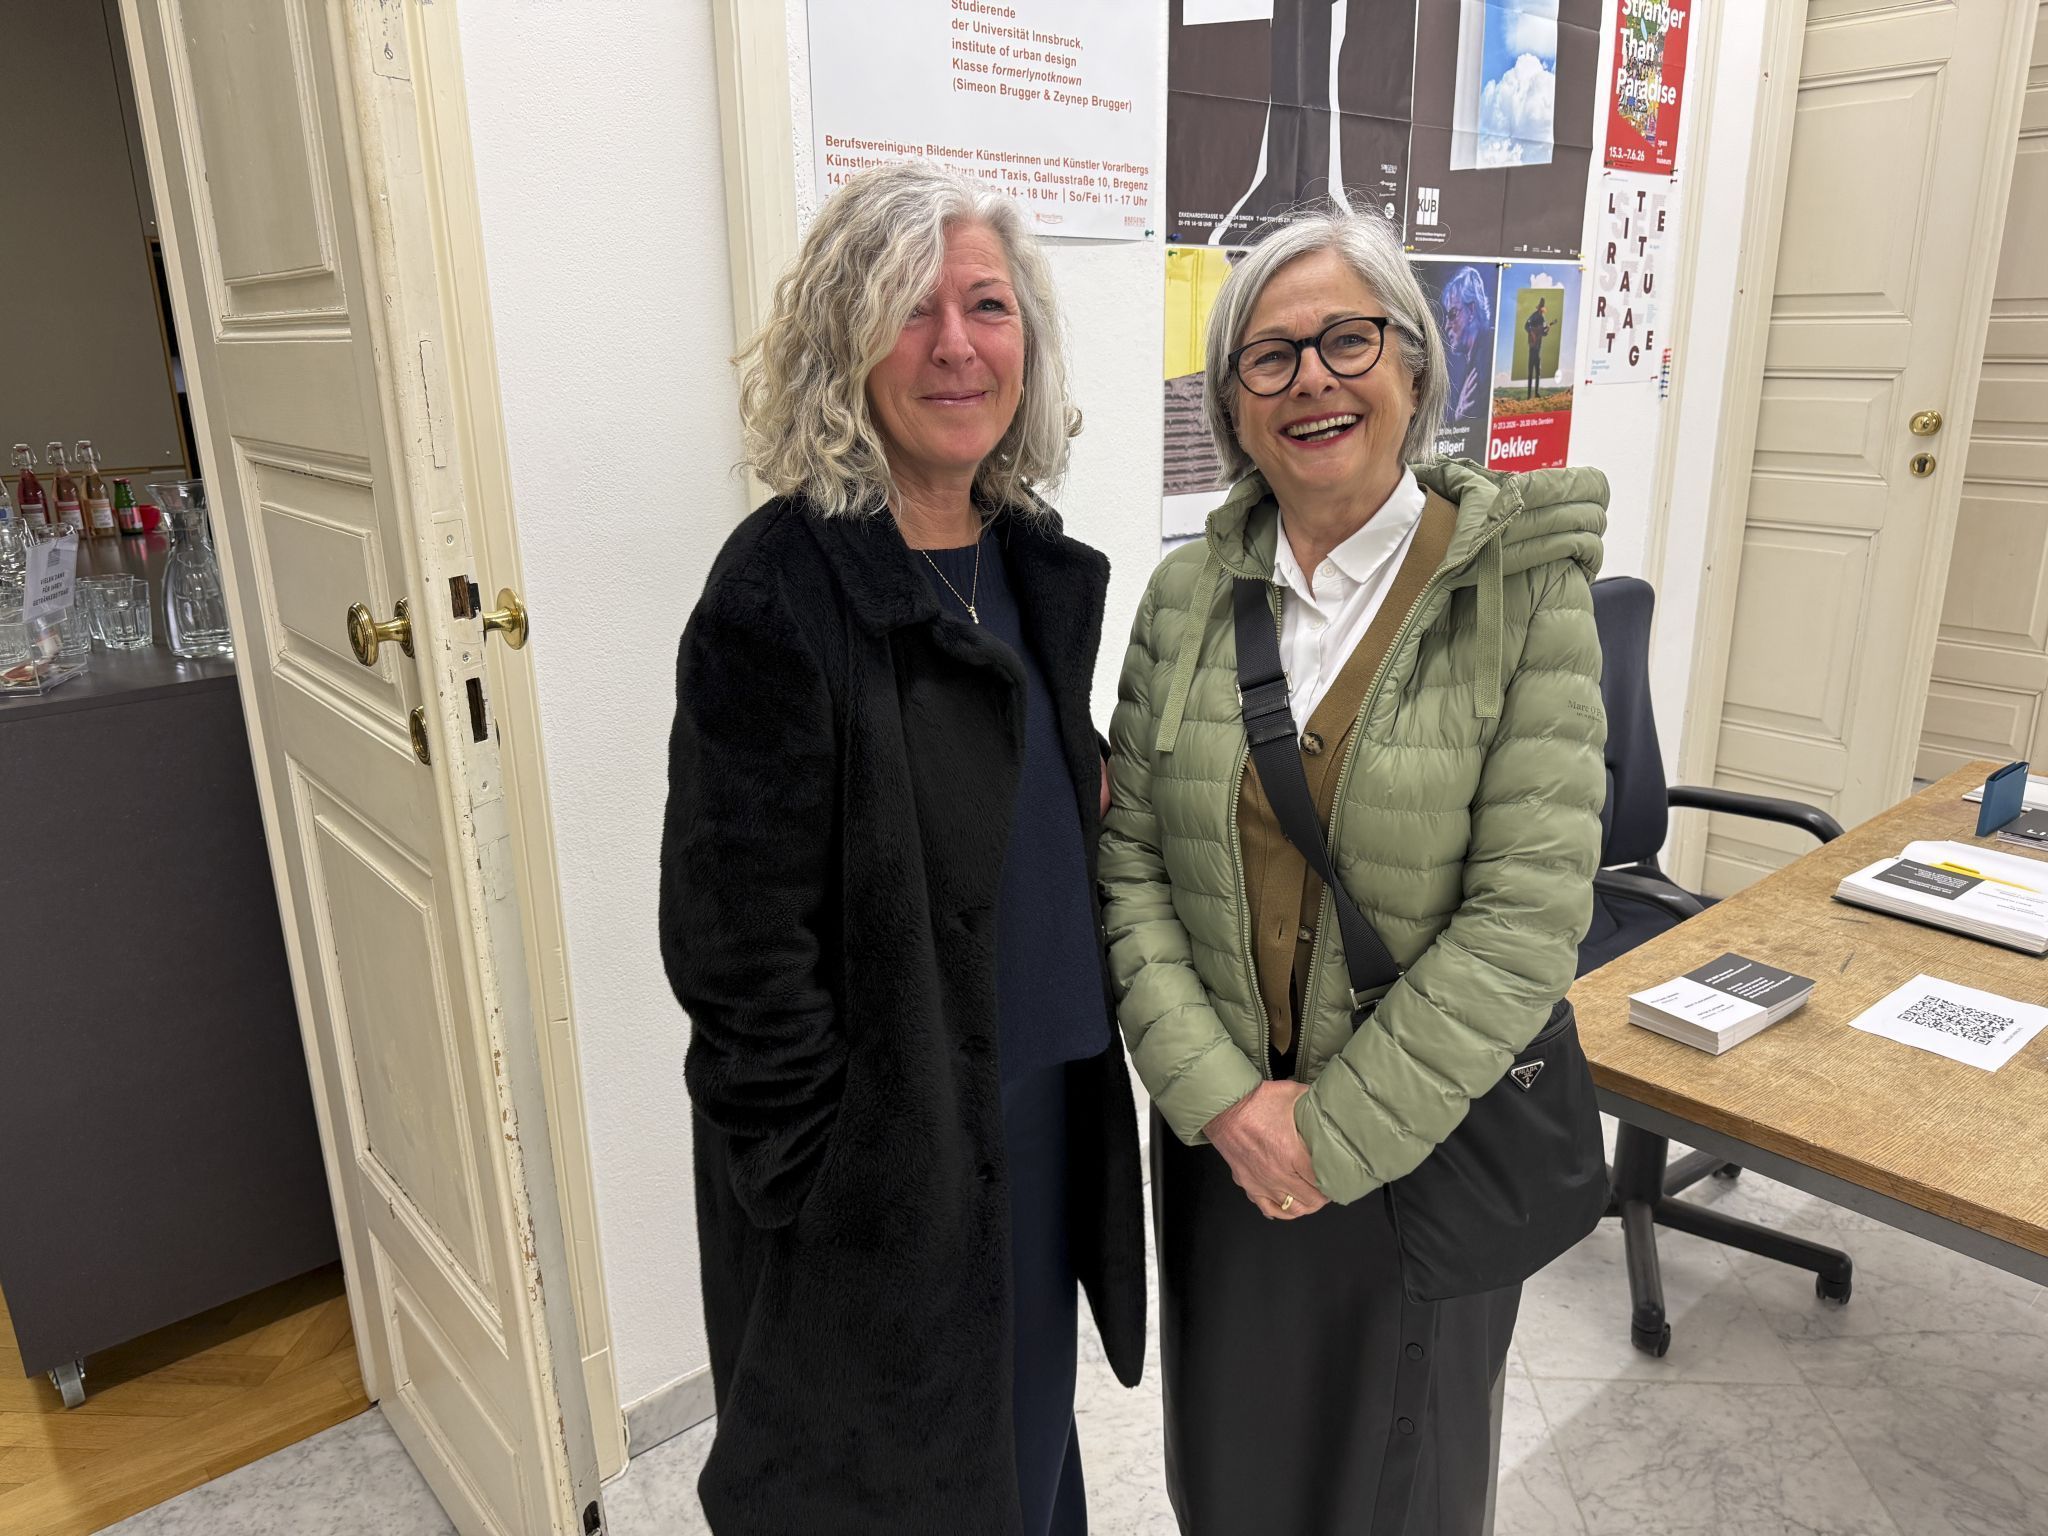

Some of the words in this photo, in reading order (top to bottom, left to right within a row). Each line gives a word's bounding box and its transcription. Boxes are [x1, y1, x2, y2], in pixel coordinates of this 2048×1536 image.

[951, 0, 1016, 18] Studierende
[1621, 0, 1686, 32] Stranger
[951, 18, 969, 31] der
[973, 21, 1029, 40] Universität
[1032, 30, 1084, 50] Innsbruck,
[1620, 27, 1655, 62] Than
[951, 38, 996, 55] institute
[1000, 46, 1010, 57] of
[1013, 48, 1042, 62] urban
[1044, 52, 1077, 69] design
[952, 57, 988, 73] Klasse
[991, 63, 1082, 86] formerlynotknown
[1616, 67, 1676, 105] Paradise
[952, 77, 996, 94] (Simeon
[1000, 84, 1040, 101] Brugger
[1043, 89, 1051, 101] &
[1053, 91, 1089, 107] Zeynep
[1092, 95, 1132, 112] Brugger)
[825, 135, 923, 156] Berufsvereinigung
[926, 145, 973, 159] Bildender
[976, 149, 1041, 166] Künstlerinnen
[1043, 157, 1061, 167] und
[1063, 157, 1101, 170] Künstler
[1102, 161, 1149, 176] Vorarlbergs
[979, 168, 998, 179] und
[1001, 168, 1031, 182] Taxis,
[1034, 171, 1095, 187] Gallusstraße
[1098, 177, 1110, 189] 10,
[1113, 178, 1148, 192] Bregenz
[1006, 187, 1017, 198] 14
[1027, 188, 1038, 199] 18
[1041, 190, 1058, 201] Uhr
[1069, 191, 1101, 203] So/Fei
[1133, 196, 1148, 206] Uhr
[1419, 199, 1437, 213] KUB
[1438, 438, 1465, 456] Bilgeri
[1490, 436, 1538, 460] Dekker
[1517, 1066, 1538, 1076] PRADA
